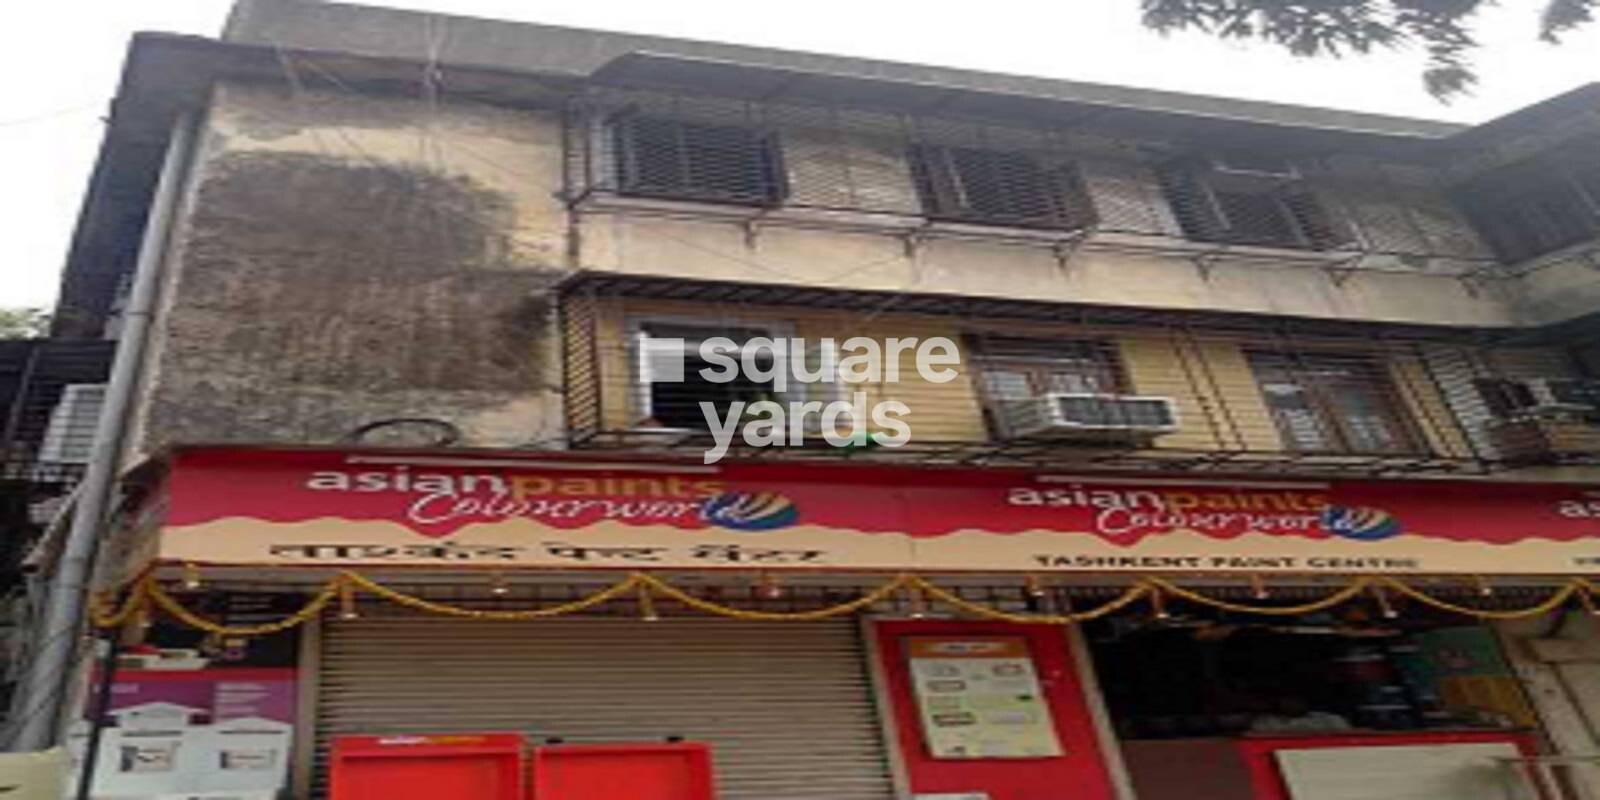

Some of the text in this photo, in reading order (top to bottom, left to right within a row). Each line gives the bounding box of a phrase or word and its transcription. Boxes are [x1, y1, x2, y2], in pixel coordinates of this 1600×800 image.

[1035, 554, 1418, 568] TASHKENT PAINT CENTRE
